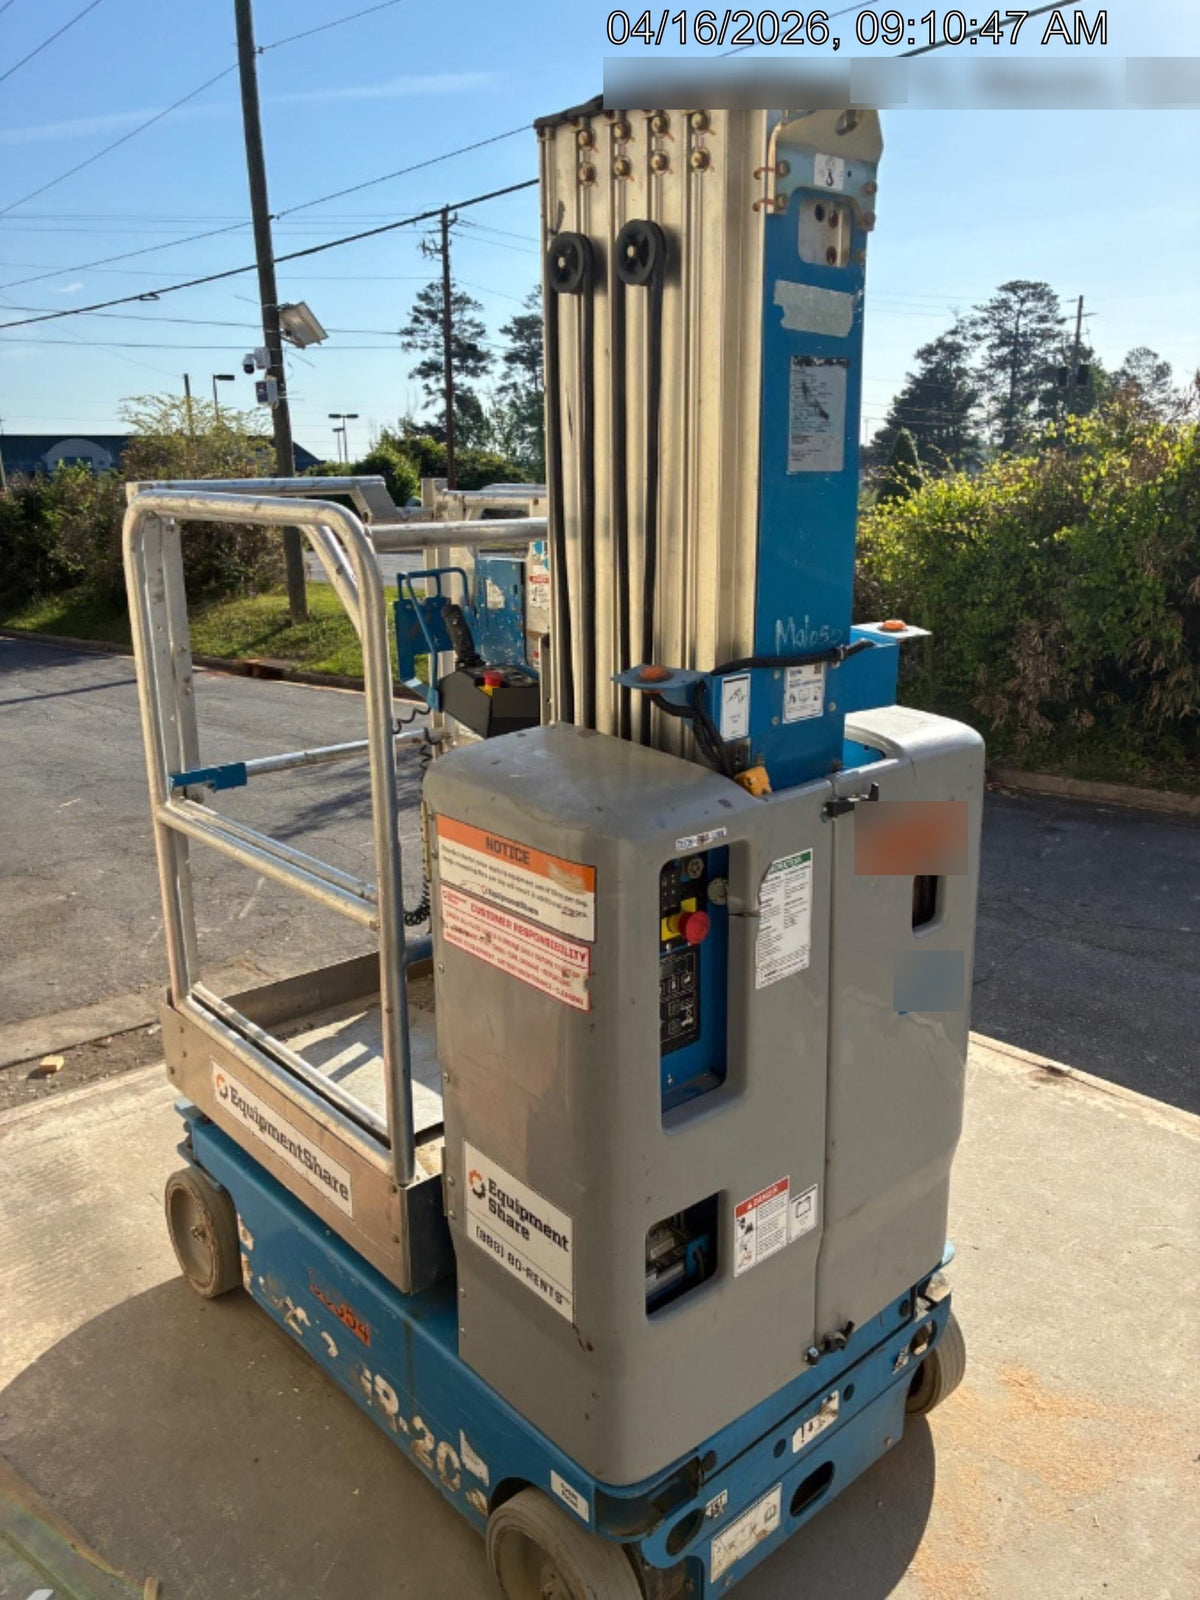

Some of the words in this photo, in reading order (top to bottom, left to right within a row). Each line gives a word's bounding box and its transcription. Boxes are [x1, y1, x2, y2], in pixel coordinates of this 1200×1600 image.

[485, 836, 530, 865] NOTICE
[470, 903, 513, 928] CUSTOMER
[513, 922, 586, 962] RESPONSIBILITY
[230, 1083, 349, 1201] EquipmentShare
[488, 1178, 570, 1252] Equipment
[488, 1197, 531, 1241] Share
